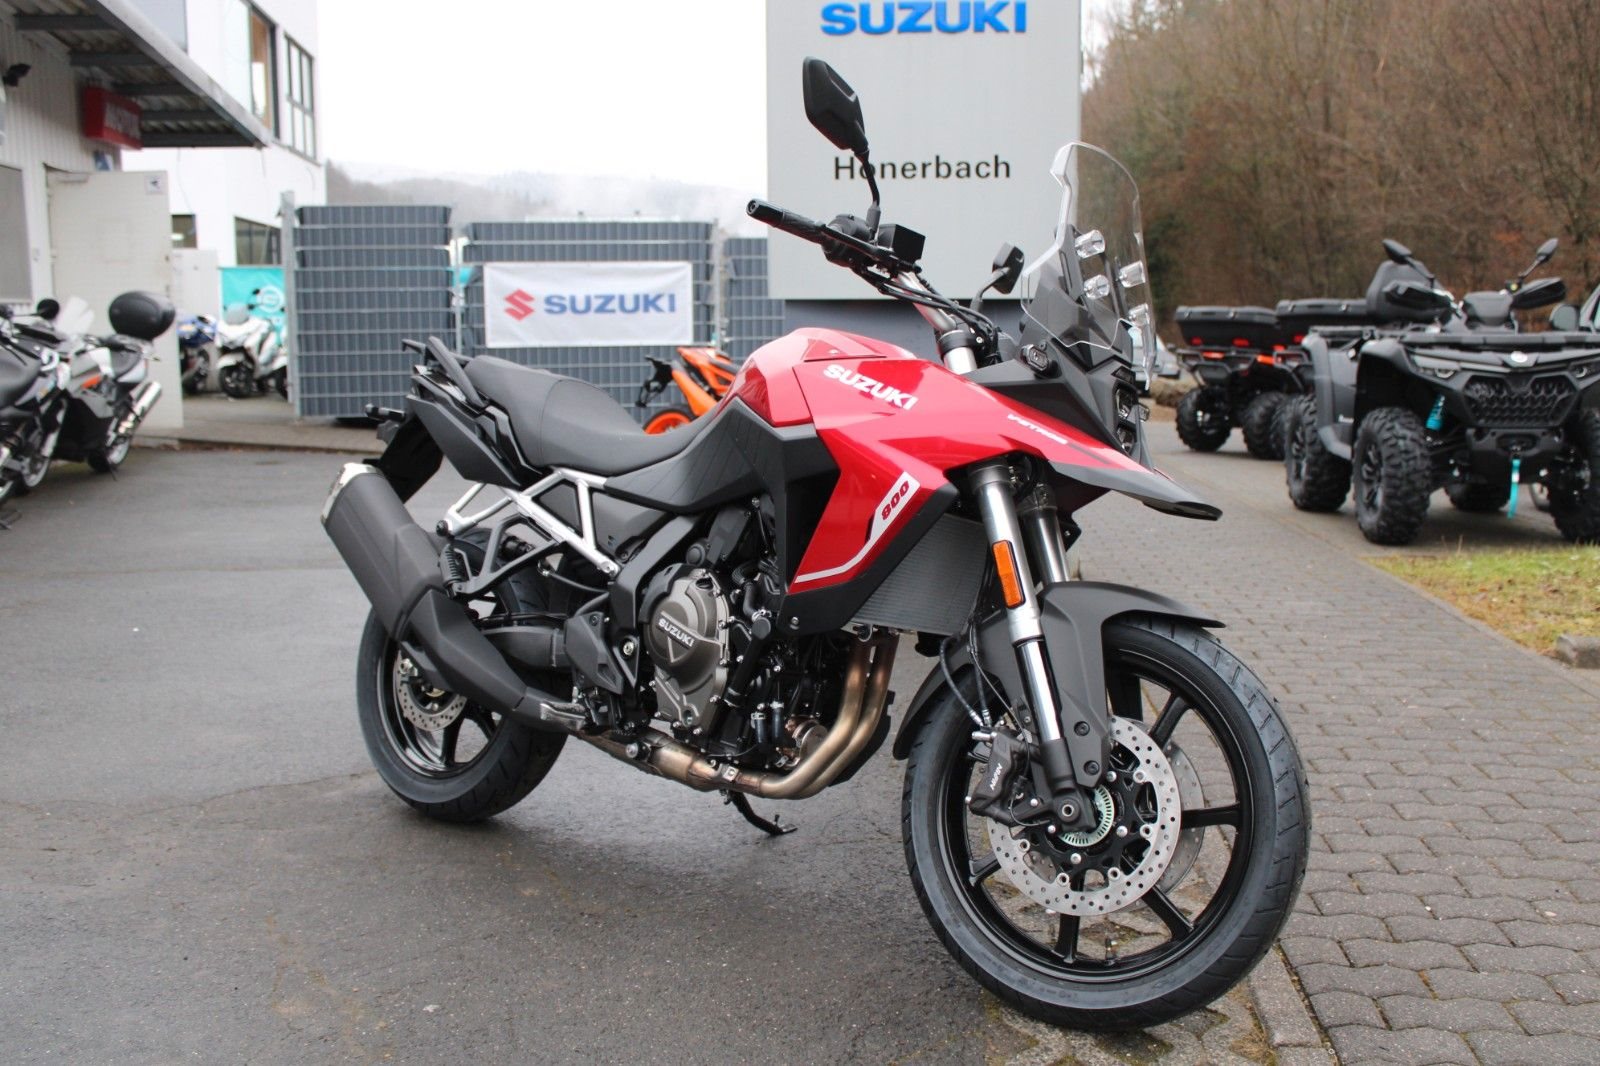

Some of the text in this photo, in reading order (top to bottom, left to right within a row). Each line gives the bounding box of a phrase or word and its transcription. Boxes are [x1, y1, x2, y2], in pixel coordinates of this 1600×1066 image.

[821, 1, 1027, 35] SUZUKI
[543, 293, 676, 315] SUZUKI
[823, 364, 918, 410] SUZUKI
[881, 480, 910, 521] 800
[658, 618, 695, 647] SUZUKI
